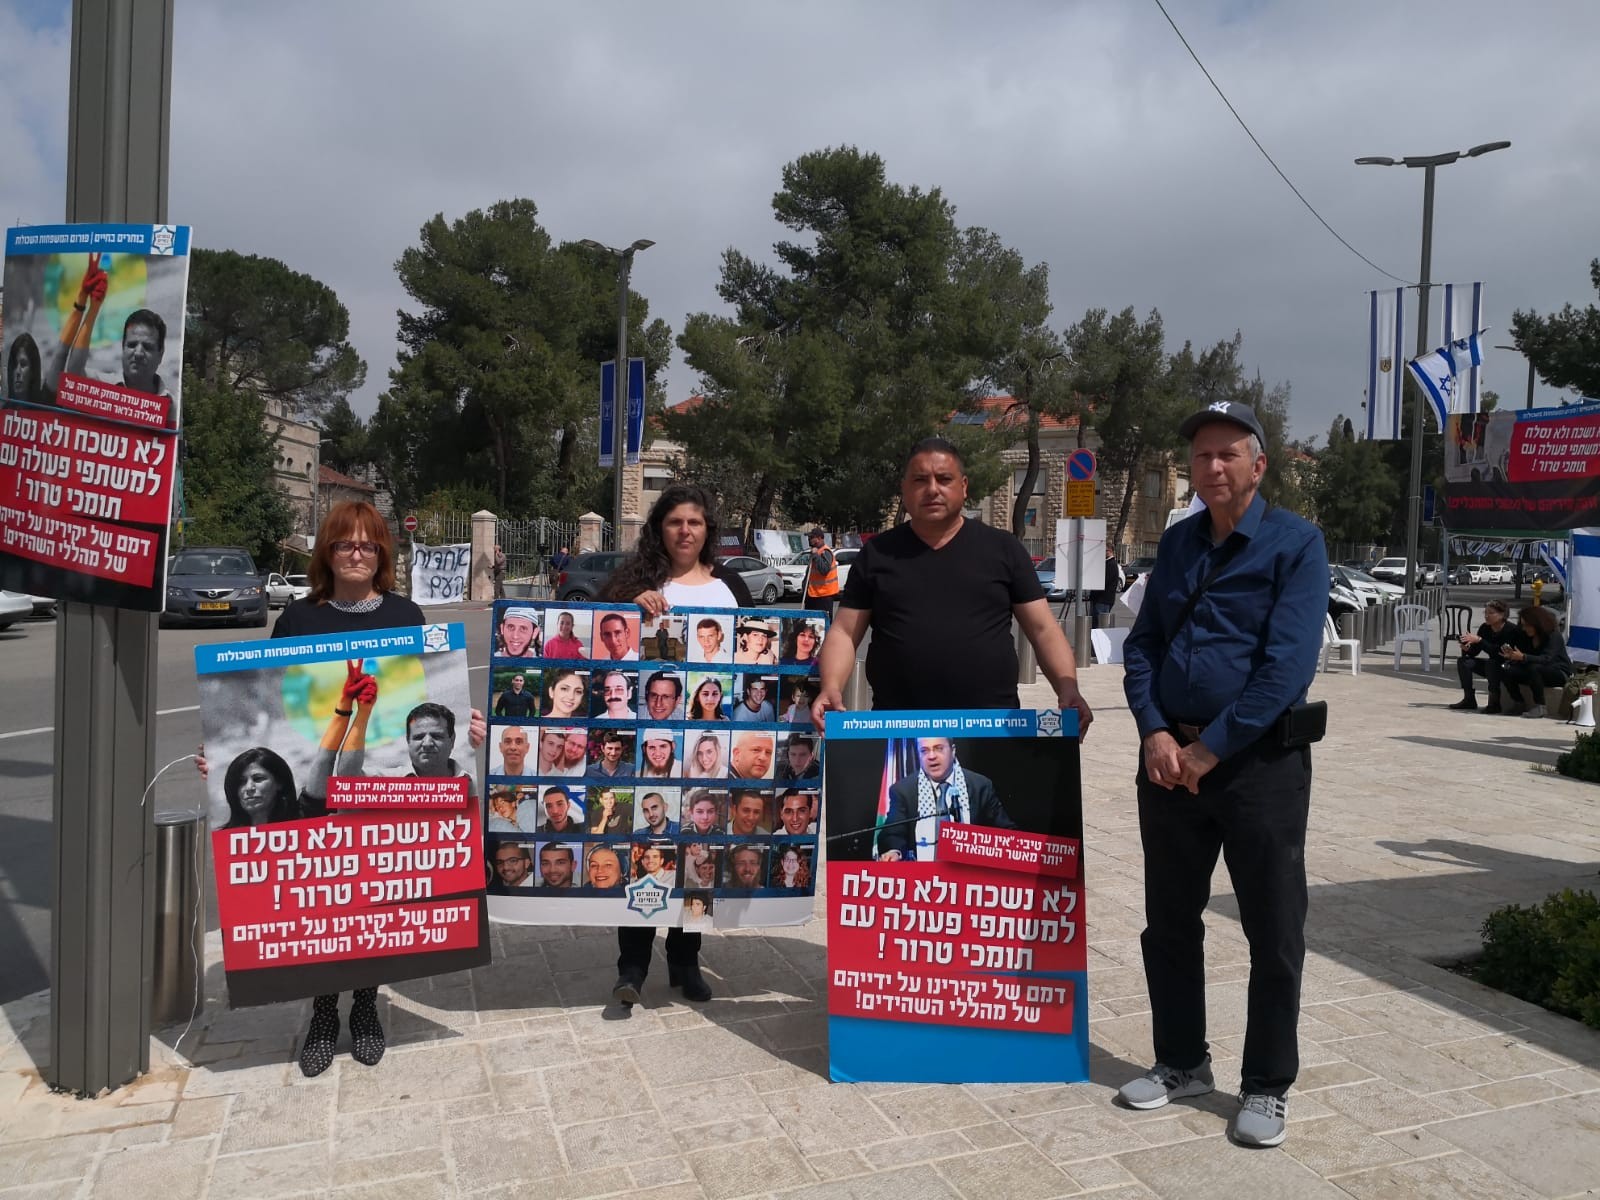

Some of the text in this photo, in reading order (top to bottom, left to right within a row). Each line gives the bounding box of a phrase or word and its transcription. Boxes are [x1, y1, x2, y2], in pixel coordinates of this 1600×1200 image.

[94, 233, 115, 244] בחיים
[117, 233, 145, 244] בוחרים
[64, 377, 75, 390] של
[77, 382, 89, 393] ידה
[90, 385, 100, 396] את
[121, 393, 140, 406] עודה
[141, 398, 162, 412] איימן
[3, 410, 166, 466] לא נשכח ולא נסלח
[1525, 425, 1552, 438] נסלח
[1553, 425, 1570, 439] ולא
[1570, 426, 1596, 438] נשכח
[1521, 443, 1537, 455] עם
[1537, 441, 1568, 456] פעולה
[0, 444, 162, 496] למשתפי פעולה עם
[1538, 460, 1561, 473] טרור
[1561, 460, 1587, 473] תומכי
[26, 478, 62, 507] טרור
[67, 487, 123, 521] תומכי
[0, 505, 151, 557] דמם של יקירינו על ידייה
[4, 525, 128, 574] של מהללי השהידים!
[318, 641, 344, 654] פורום
[350, 637, 379, 650] בחיים
[380, 634, 415, 647] בוחרים
[216, 649, 262, 663] השכולות
[264, 644, 314, 658] המשפחות
[842, 719, 884, 730] השכולות
[885, 719, 931, 730] המשפחות
[932, 718, 959, 729] פורום
[965, 717, 993, 729] בחיים
[994, 717, 1028, 729] בוחרים
[336, 779, 461, 794] איימן עודה מחזק את ידה של
[331, 793, 353, 804] טרור
[354, 793, 379, 805] ארגון
[380, 793, 406, 804] חברת
[229, 815, 471, 856] לא נשכח ולא נסלח
[941, 827, 969, 842] נעלה
[970, 832, 992, 847] ערך
[1016, 838, 1043, 851] טיבי:
[1045, 842, 1076, 857] אחמד
[229, 842, 472, 885] למשתפי פעולה עם
[1005, 850, 1038, 863] מאשר
[1041, 853, 1063, 866] יותר
[290, 882, 352, 909] טרור
[360, 877, 433, 903] תומכי
[842, 870, 1077, 914] לא נשכח ולא נסלח
[233, 905, 471, 942] דמם של יקירינו על ידייהם
[840, 903, 1077, 943] למשתפי פעולה עם
[258, 926, 448, 960] של מהללי השהידים!
[894, 937, 953, 965] טרור
[961, 943, 1033, 970] תומכי
[834, 969, 1066, 1004] דמם של יקירינו על ידייהם
[856, 990, 1041, 1023] של מהללי השהידים!
